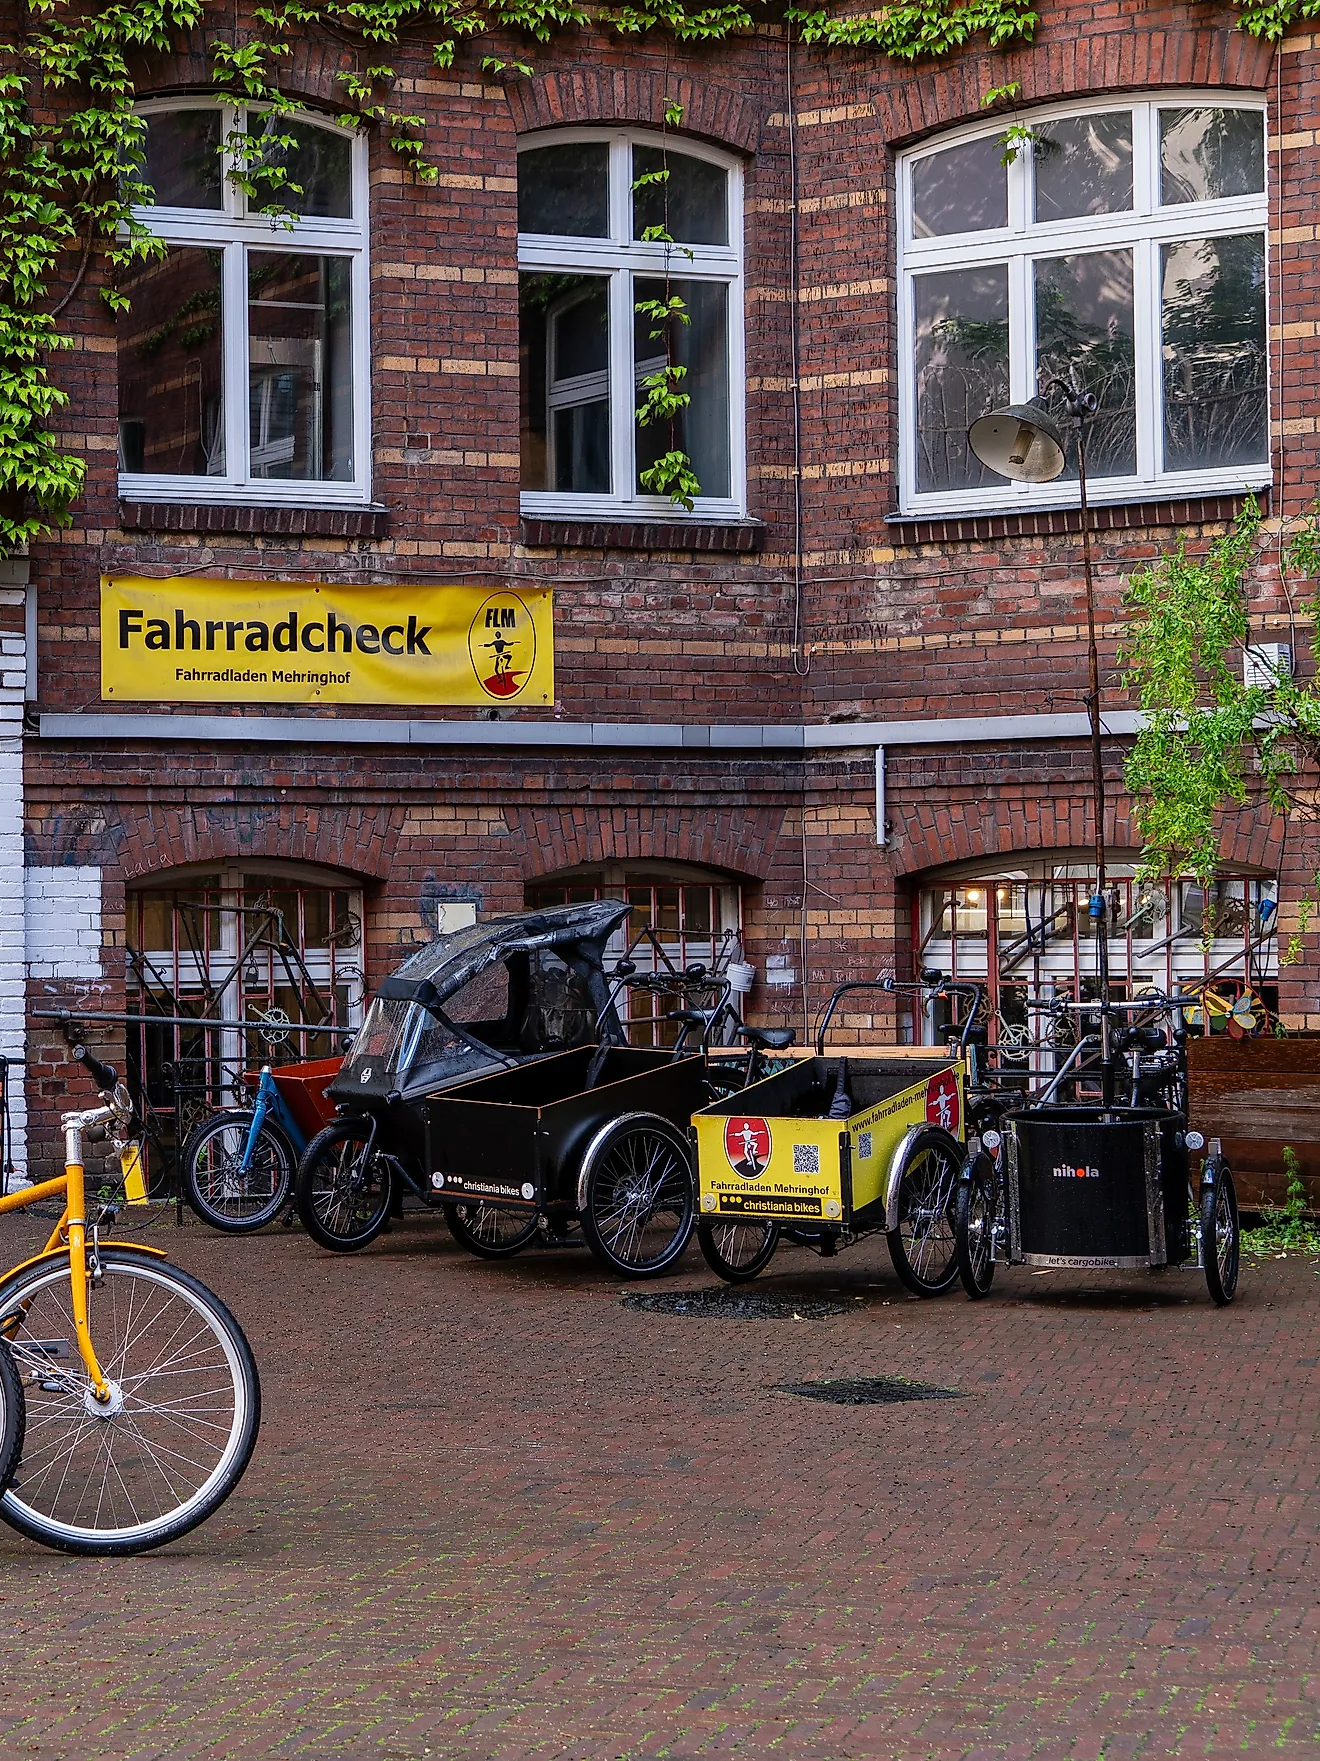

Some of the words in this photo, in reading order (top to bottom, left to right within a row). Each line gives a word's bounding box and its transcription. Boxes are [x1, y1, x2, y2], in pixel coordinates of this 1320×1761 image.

[484, 607, 516, 629] FLM
[117, 608, 433, 656] Fahrradcheck
[175, 667, 268, 684] Fahrradladen
[271, 669, 351, 687] Mehringhof
[1052, 1163, 1100, 1178] nihola
[463, 1180, 499, 1193] christiania
[500, 1184, 520, 1196] bikes
[710, 1180, 772, 1192] Fahrradladen
[774, 1183, 830, 1196] Mehringhof
[744, 1200, 792, 1212] christiania
[794, 1201, 820, 1213] bikes
[1049, 1257, 1066, 1265] let's
